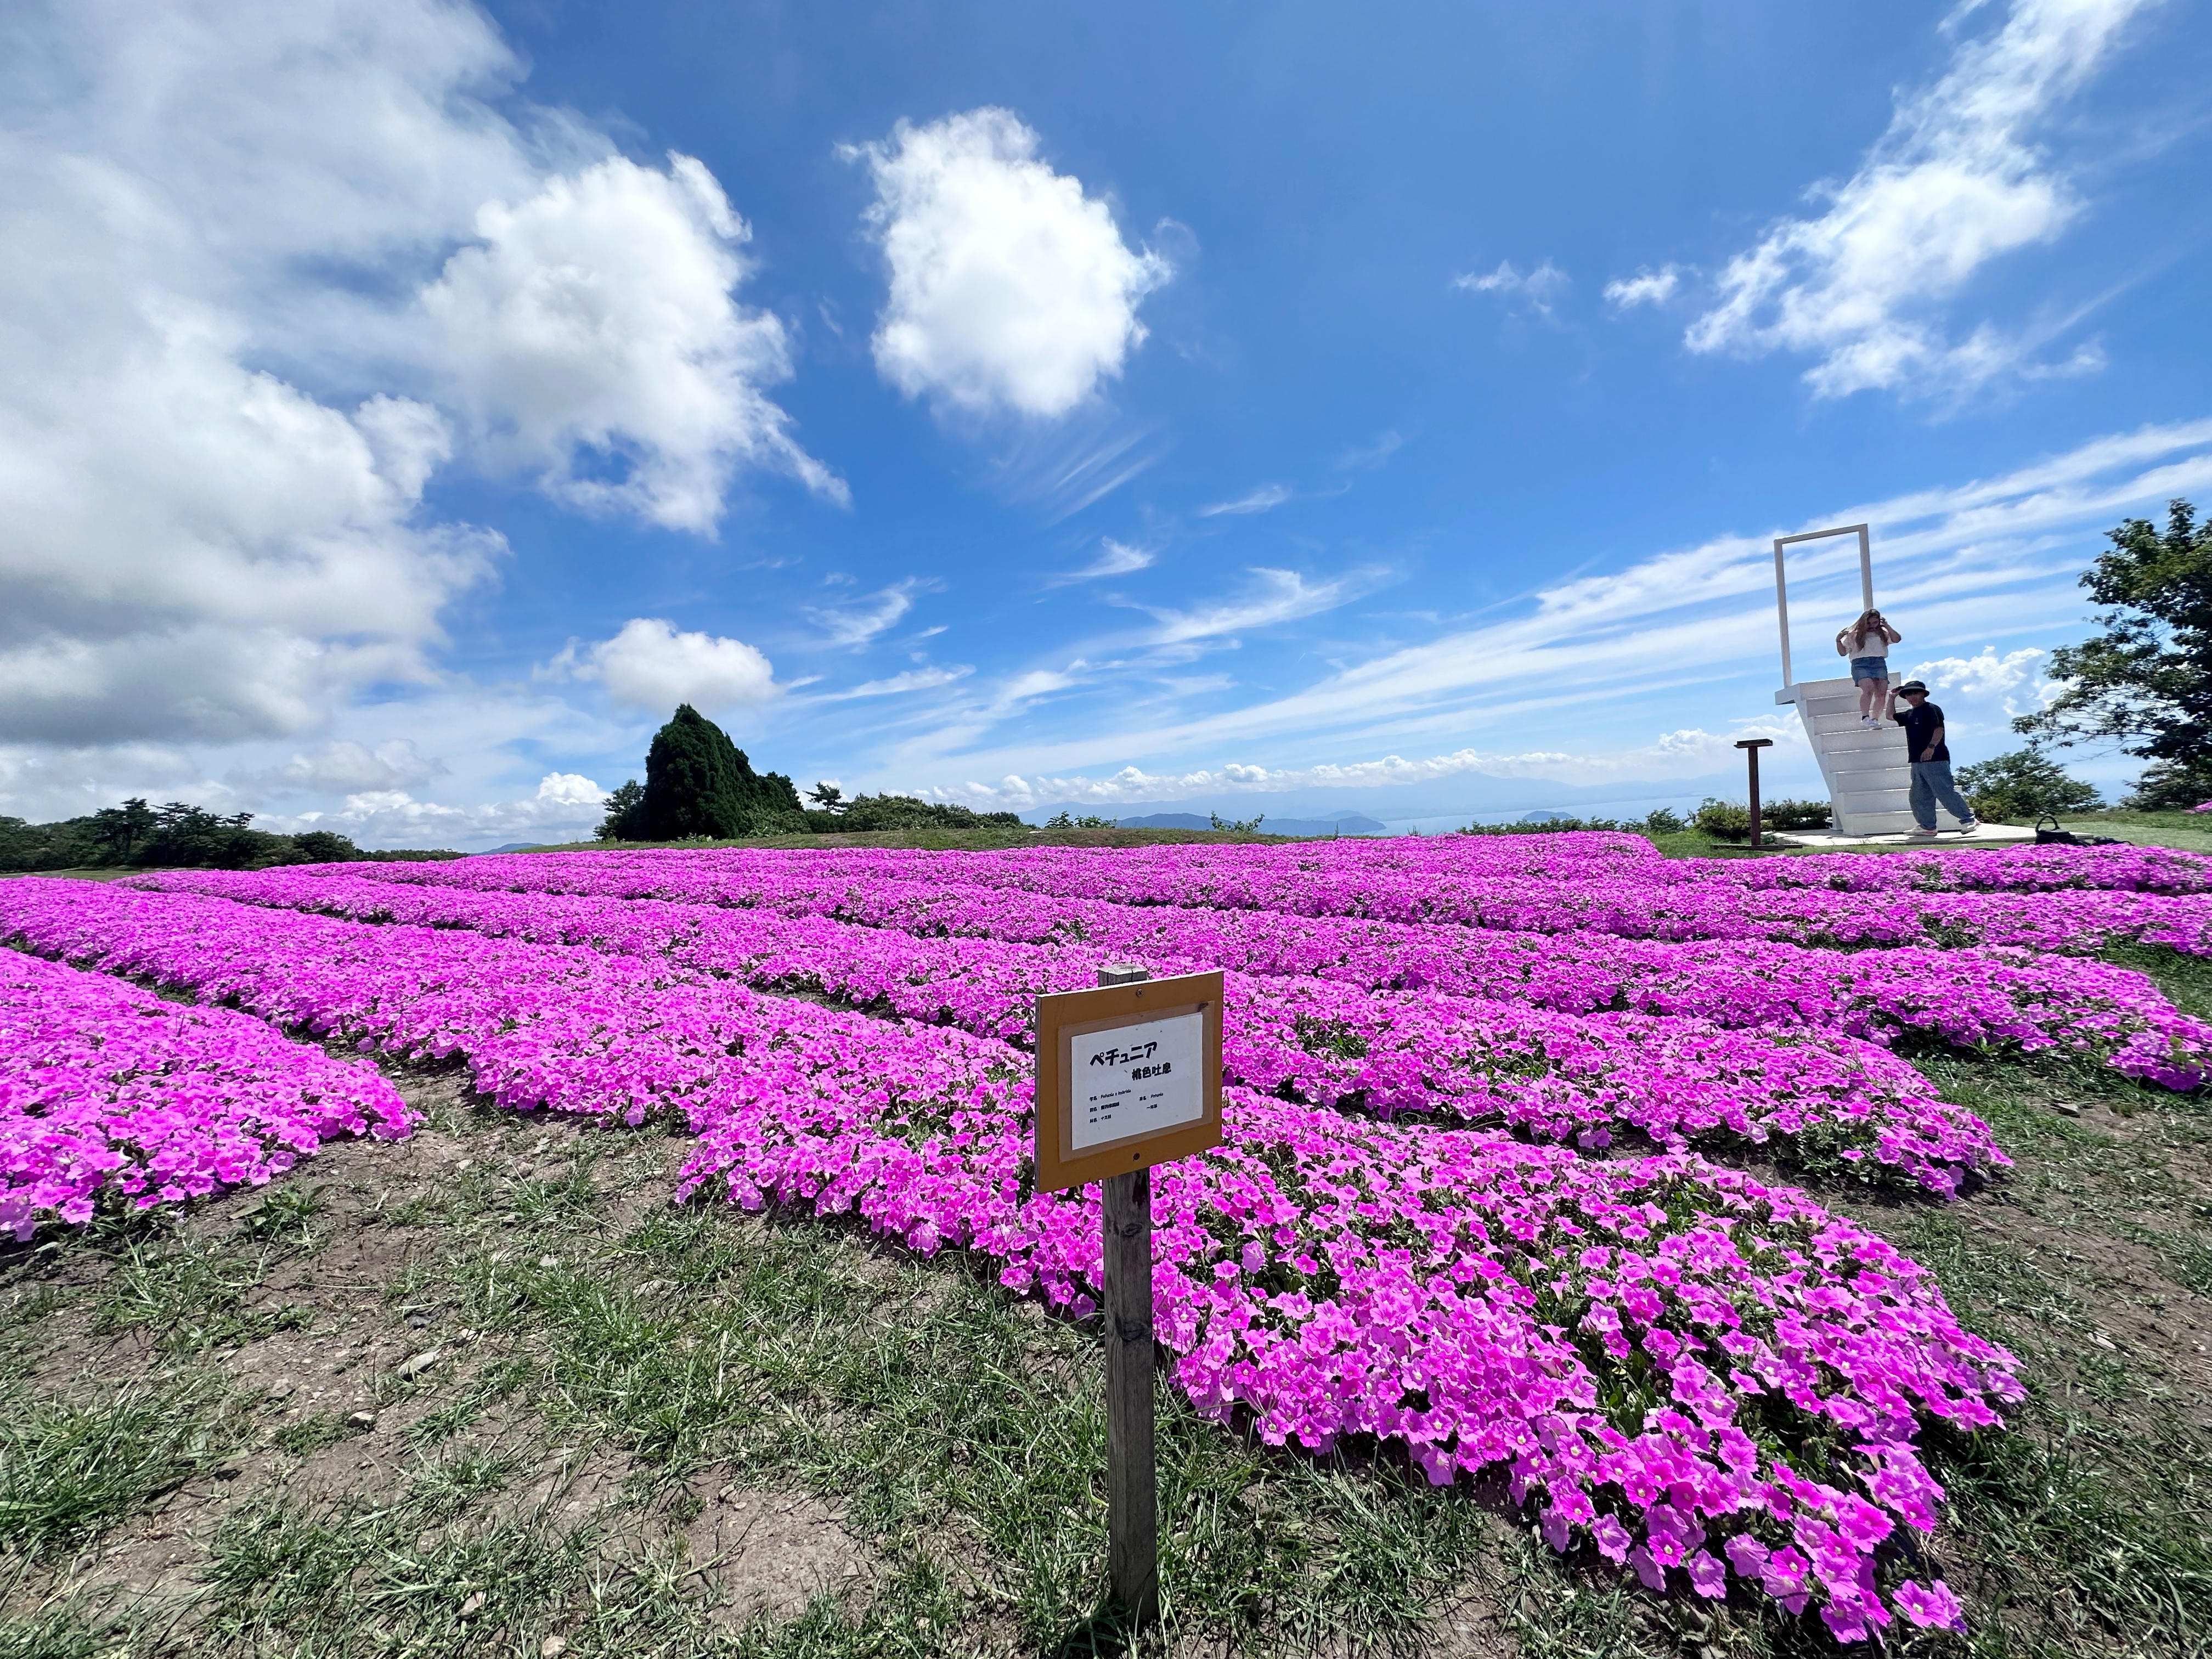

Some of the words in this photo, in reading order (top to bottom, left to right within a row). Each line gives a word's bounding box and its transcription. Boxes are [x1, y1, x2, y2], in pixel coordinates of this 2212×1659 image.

[1090, 1041, 1158, 1066] ペチュニア
[1131, 1062, 1172, 1081] 桃色吐息
